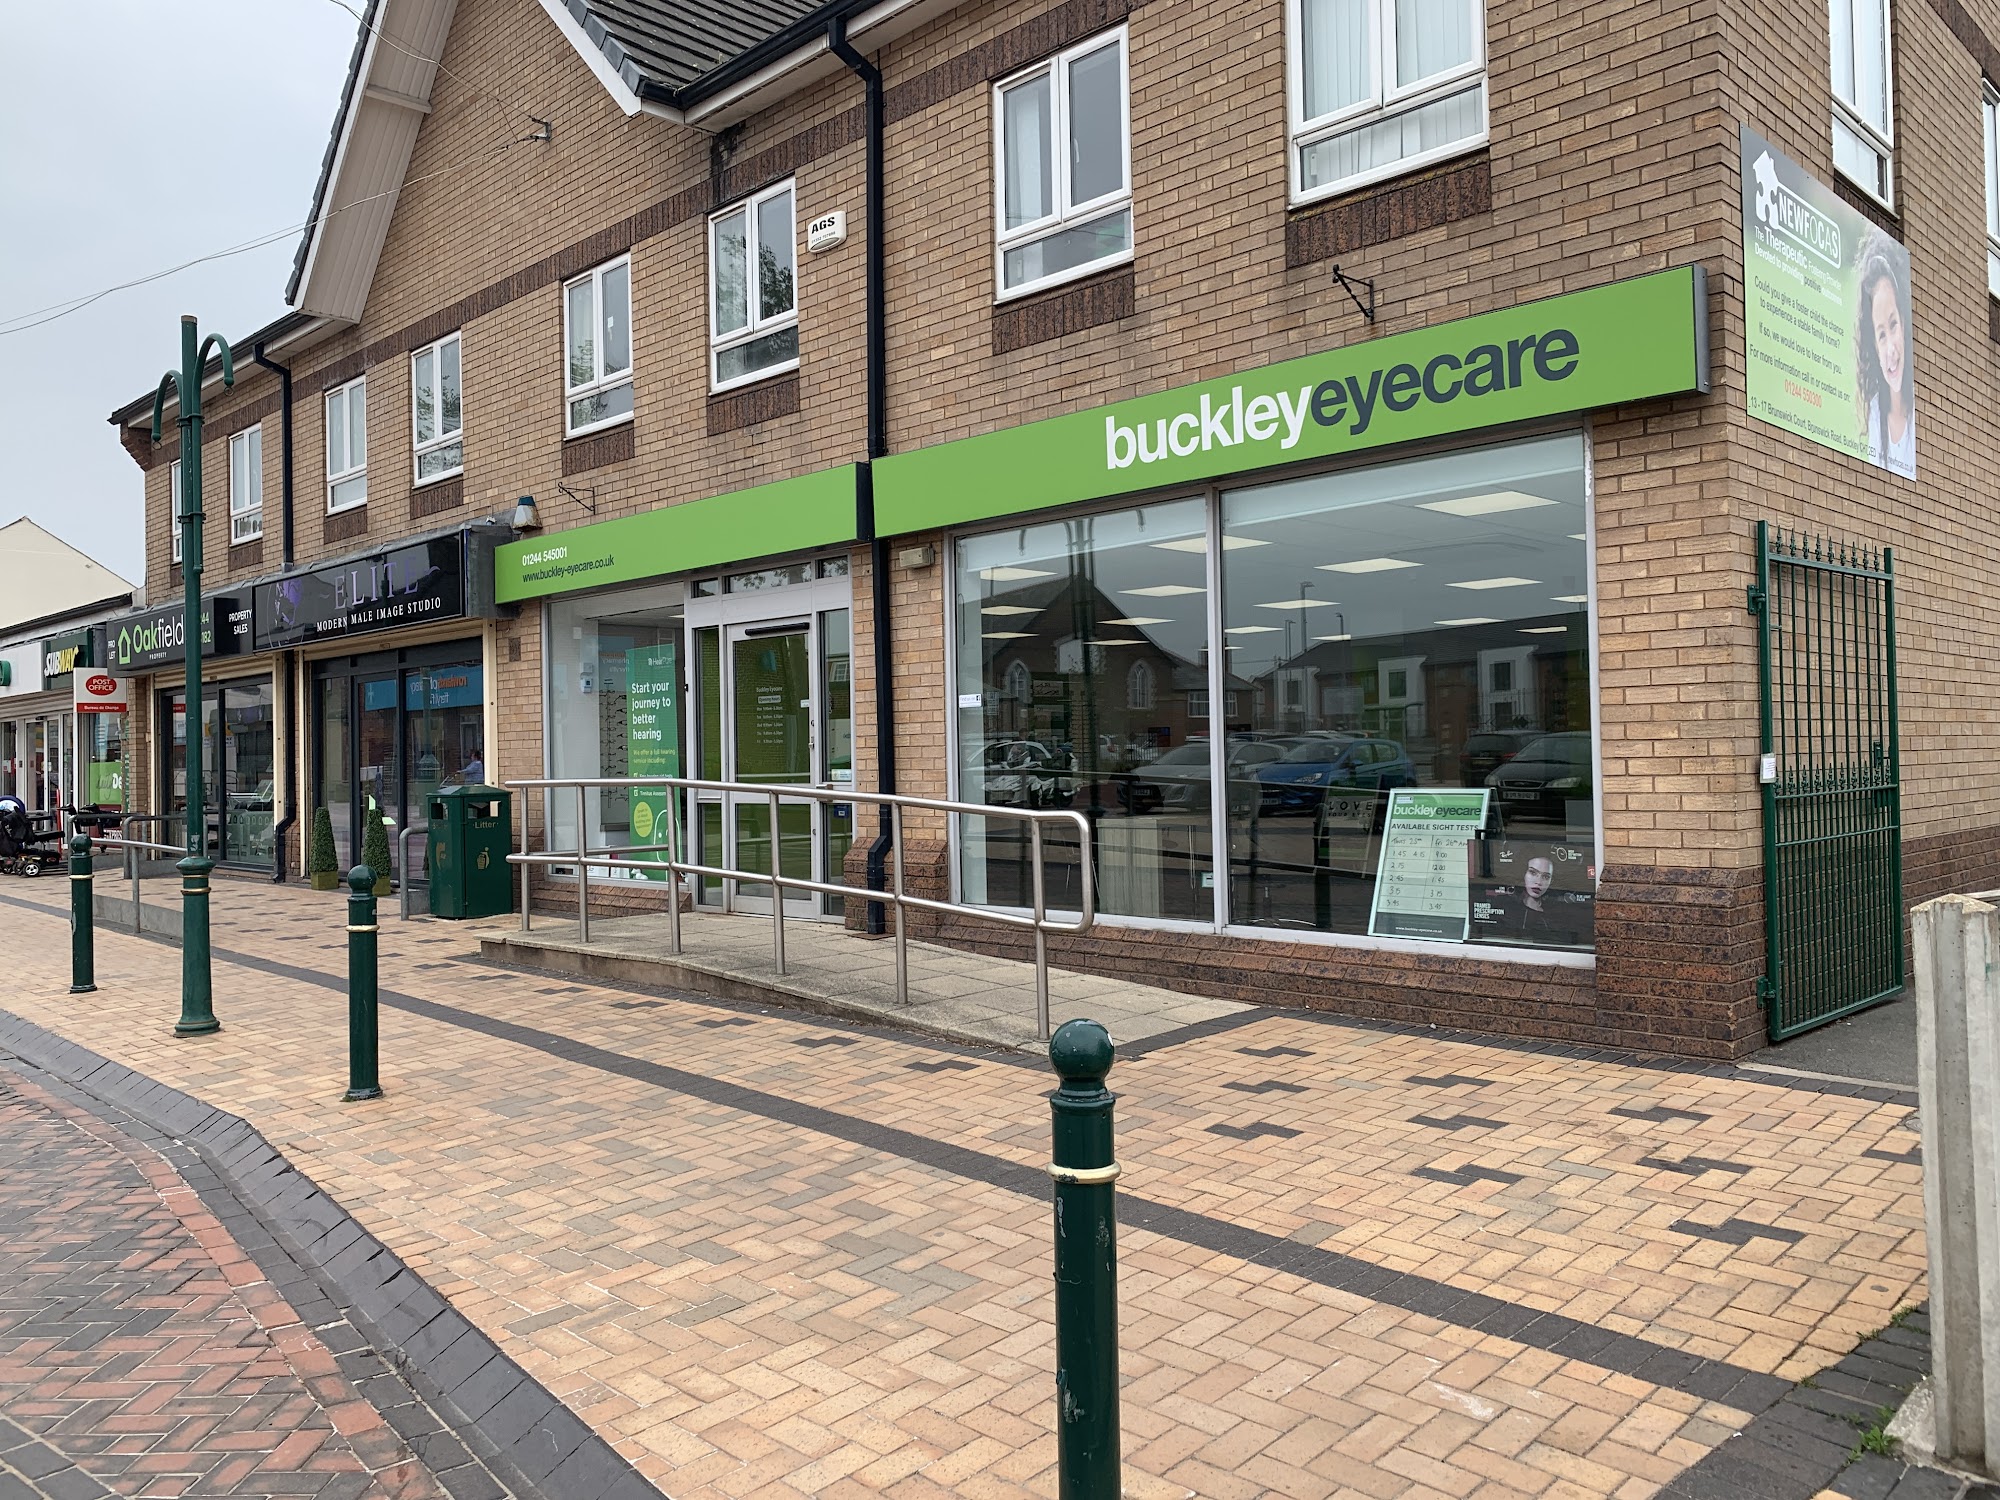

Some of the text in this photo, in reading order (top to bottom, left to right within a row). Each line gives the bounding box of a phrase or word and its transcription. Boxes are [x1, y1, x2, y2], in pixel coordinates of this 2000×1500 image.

[811, 216, 835, 234] AGS
[1778, 191, 1838, 260] NEWFOCAS
[1754, 224, 1764, 243] The
[1764, 225, 1807, 273] Therapeutic
[1754, 241, 1775, 266] Devoted
[1776, 255, 1781, 269] to
[1781, 258, 1803, 285] providing
[1754, 274, 1769, 295] Could
[1770, 286, 1780, 303] you
[1780, 290, 1791, 309] give
[1795, 297, 1809, 317] foster
[1809, 306, 1820, 323] child
[1820, 313, 1828, 328] the
[1828, 318, 1844, 337] chance
[1760, 295, 1765, 309] to
[1766, 299, 1792, 327] experience
[1797, 316, 1810, 333] stable
[1811, 323, 1824, 344] family
[1825, 331, 1840, 350] home?
[1759, 320, 1763, 334] If
[1772, 330, 1779, 343] we
[1780, 332, 1794, 351] would
[1795, 340, 1805, 356] love
[1806, 346, 1810, 359] to
[1811, 348, 1821, 364] hear
[1822, 353, 1832, 370] from
[1749, 343, 1759, 360] For
[1759, 350, 1772, 366] more
[1773, 354, 1800, 379] information
[1801, 368, 1809, 384] call
[1810, 373, 1814, 386] in
[1816, 377, 1820, 389] or
[1820, 378, 1836, 396] contact
[1837, 388, 1842, 400] us
[1106, 328, 1579, 470] buckleyeyecare
[1784, 378, 1801, 399] 01244
[1750, 395, 1756, 409] 13
[1761, 399, 1767, 413] 17
[1767, 402, 1792, 424] Brunswick
[1807, 419, 1829, 440] Brunswick
[522, 546, 567, 566] 01244 545001
[522, 554, 614, 582] www.buckley-eyecare.co.uk
[334, 557, 419, 610] ELITE
[228, 609, 252, 623] PROPERTY
[316, 597, 441, 632] MODERN MALE IMAGE STUDIO
[133, 614, 184, 653] Oakfield
[233, 624, 248, 635] SALES
[44, 647, 77, 678] SUBWAY
[631, 682, 669, 694] Start your
[632, 697, 671, 711] journey to
[632, 713, 656, 724] better
[633, 728, 661, 741] hearing
[1329, 801, 1373, 811] LOVE
[1393, 804, 1481, 817] buckleyeyecare
[475, 821, 496, 829] Litter
[1474, 907, 1505, 915] PRESCRIPTION
